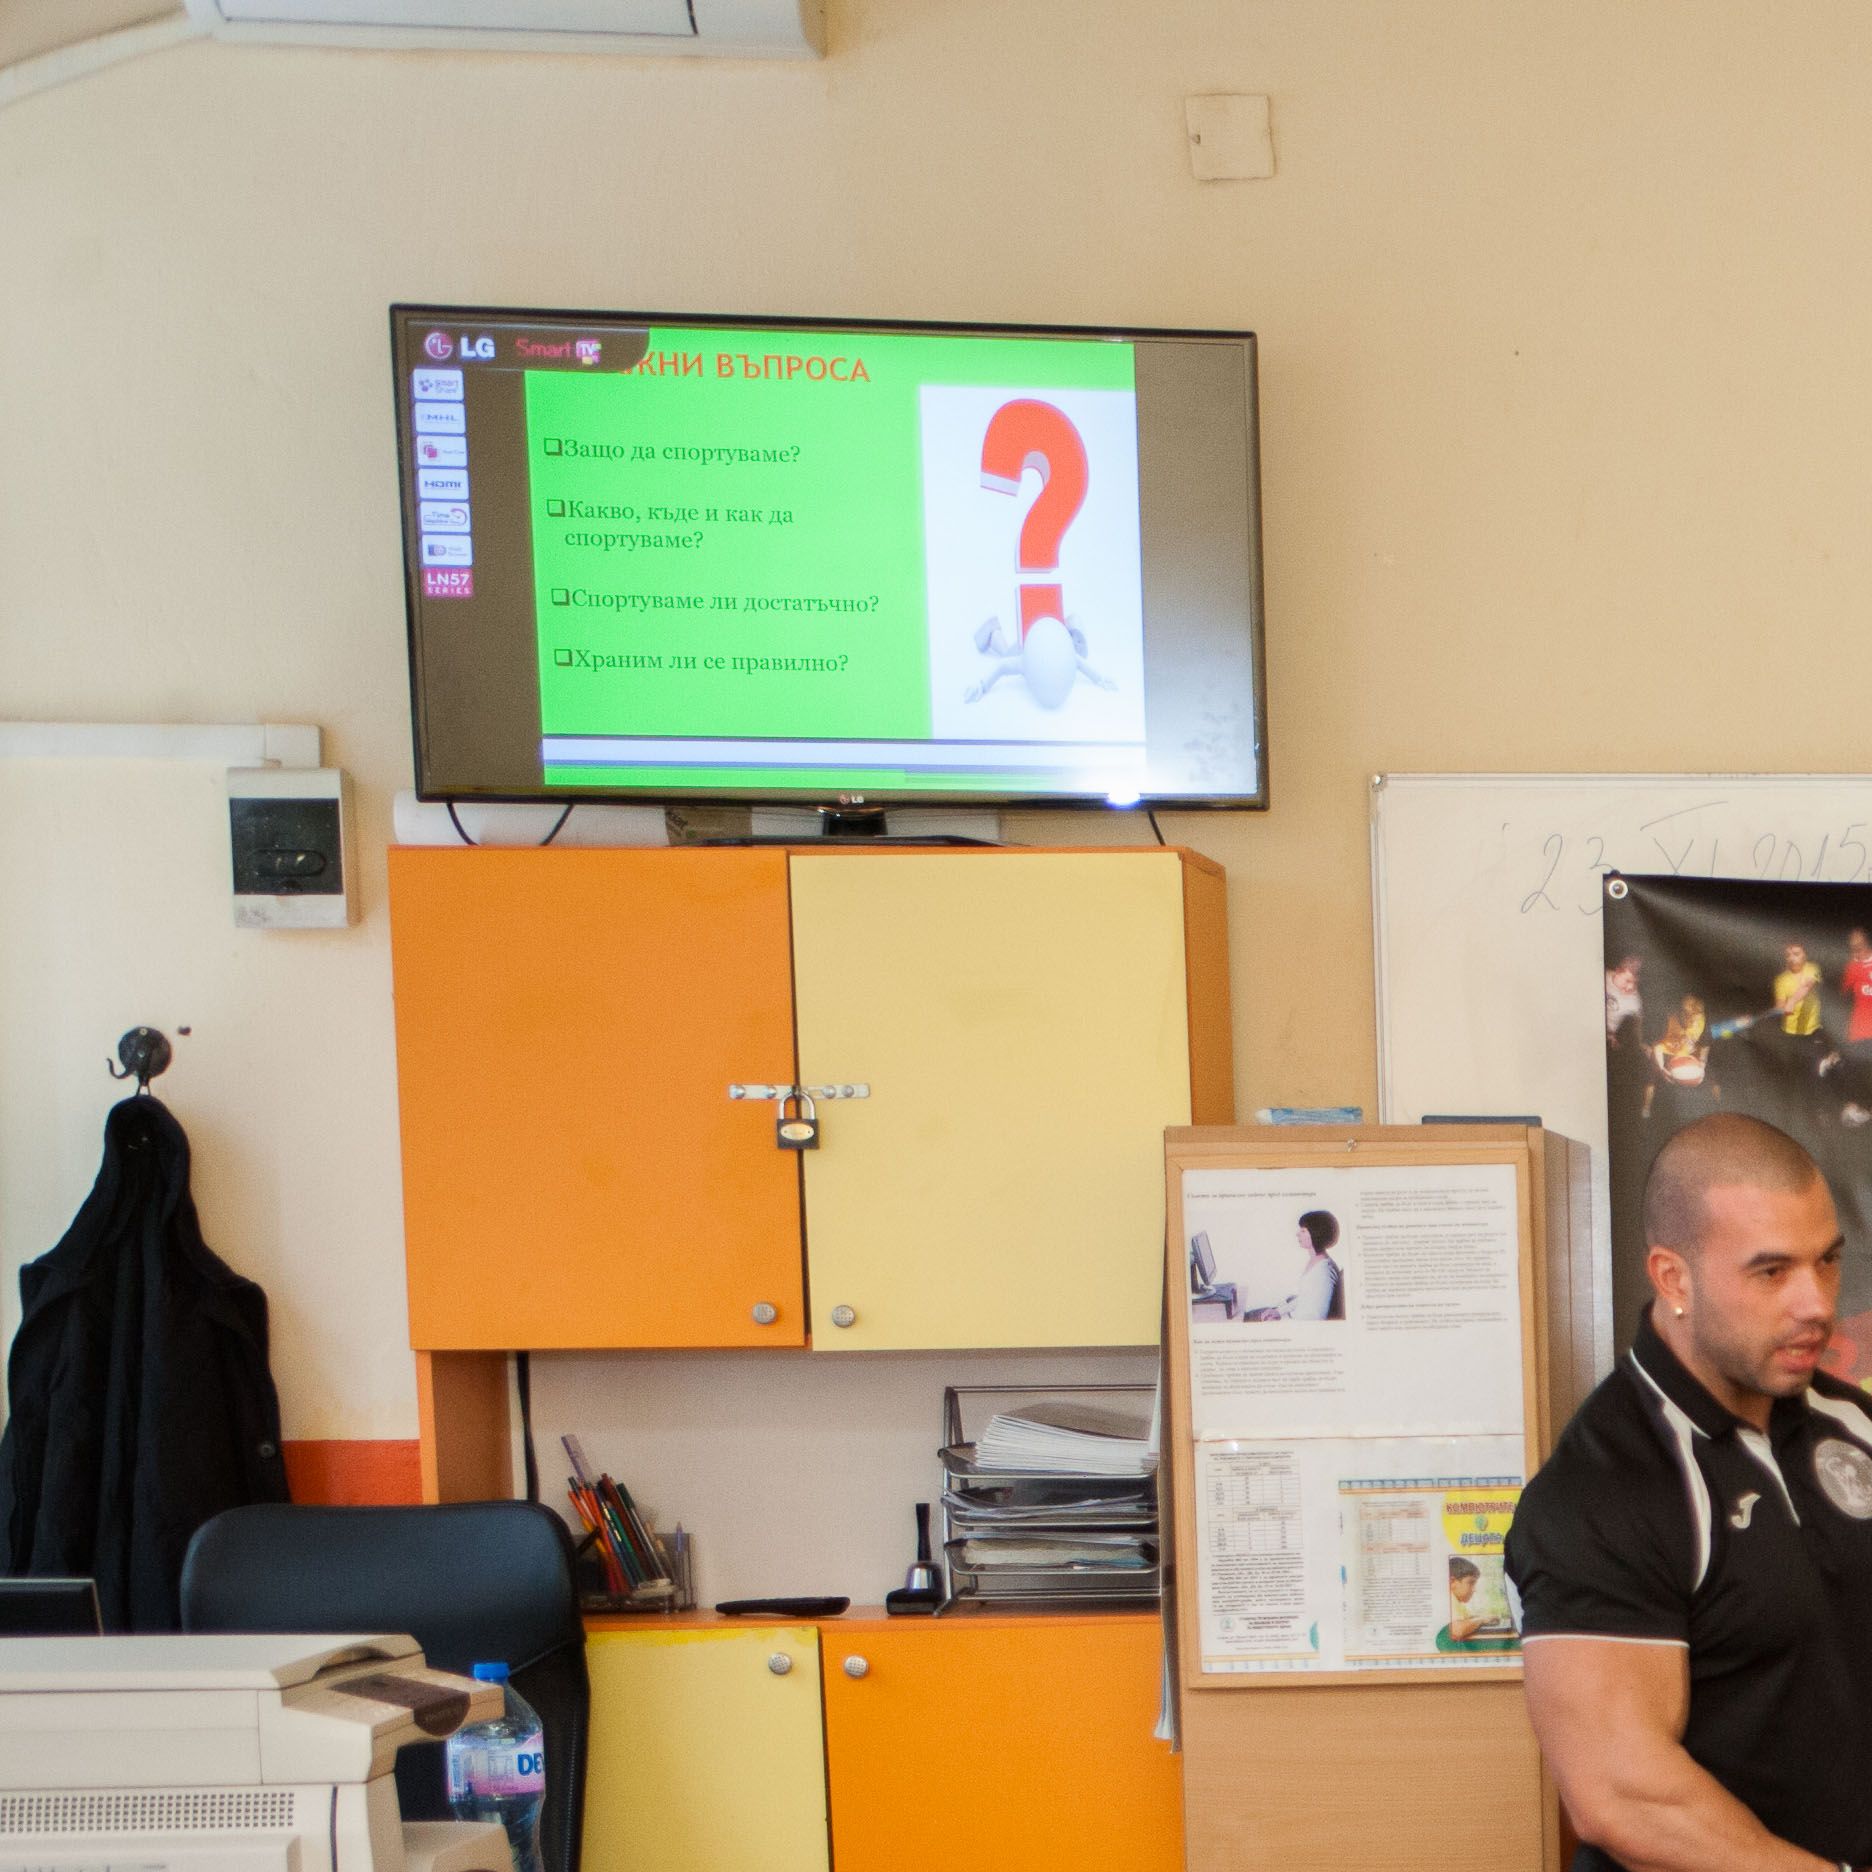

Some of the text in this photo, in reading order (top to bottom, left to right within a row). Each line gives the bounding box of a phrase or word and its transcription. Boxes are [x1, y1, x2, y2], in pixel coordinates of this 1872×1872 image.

[460, 337, 496, 359] LG
[515, 338, 570, 358] Smart
[717, 353, 872, 383] ВЪПРОСА
[563, 439, 801, 466] Защо да спортуваме?
[567, 500, 794, 525] Какво, къде и как да
[564, 530, 704, 552] спортуваме?
[426, 573, 471, 586] LN57
[427, 587, 472, 595] SERIES
[571, 589, 880, 613] Спортуваме ли достатъчно?
[574, 649, 850, 674] Храним ли се правилно?
